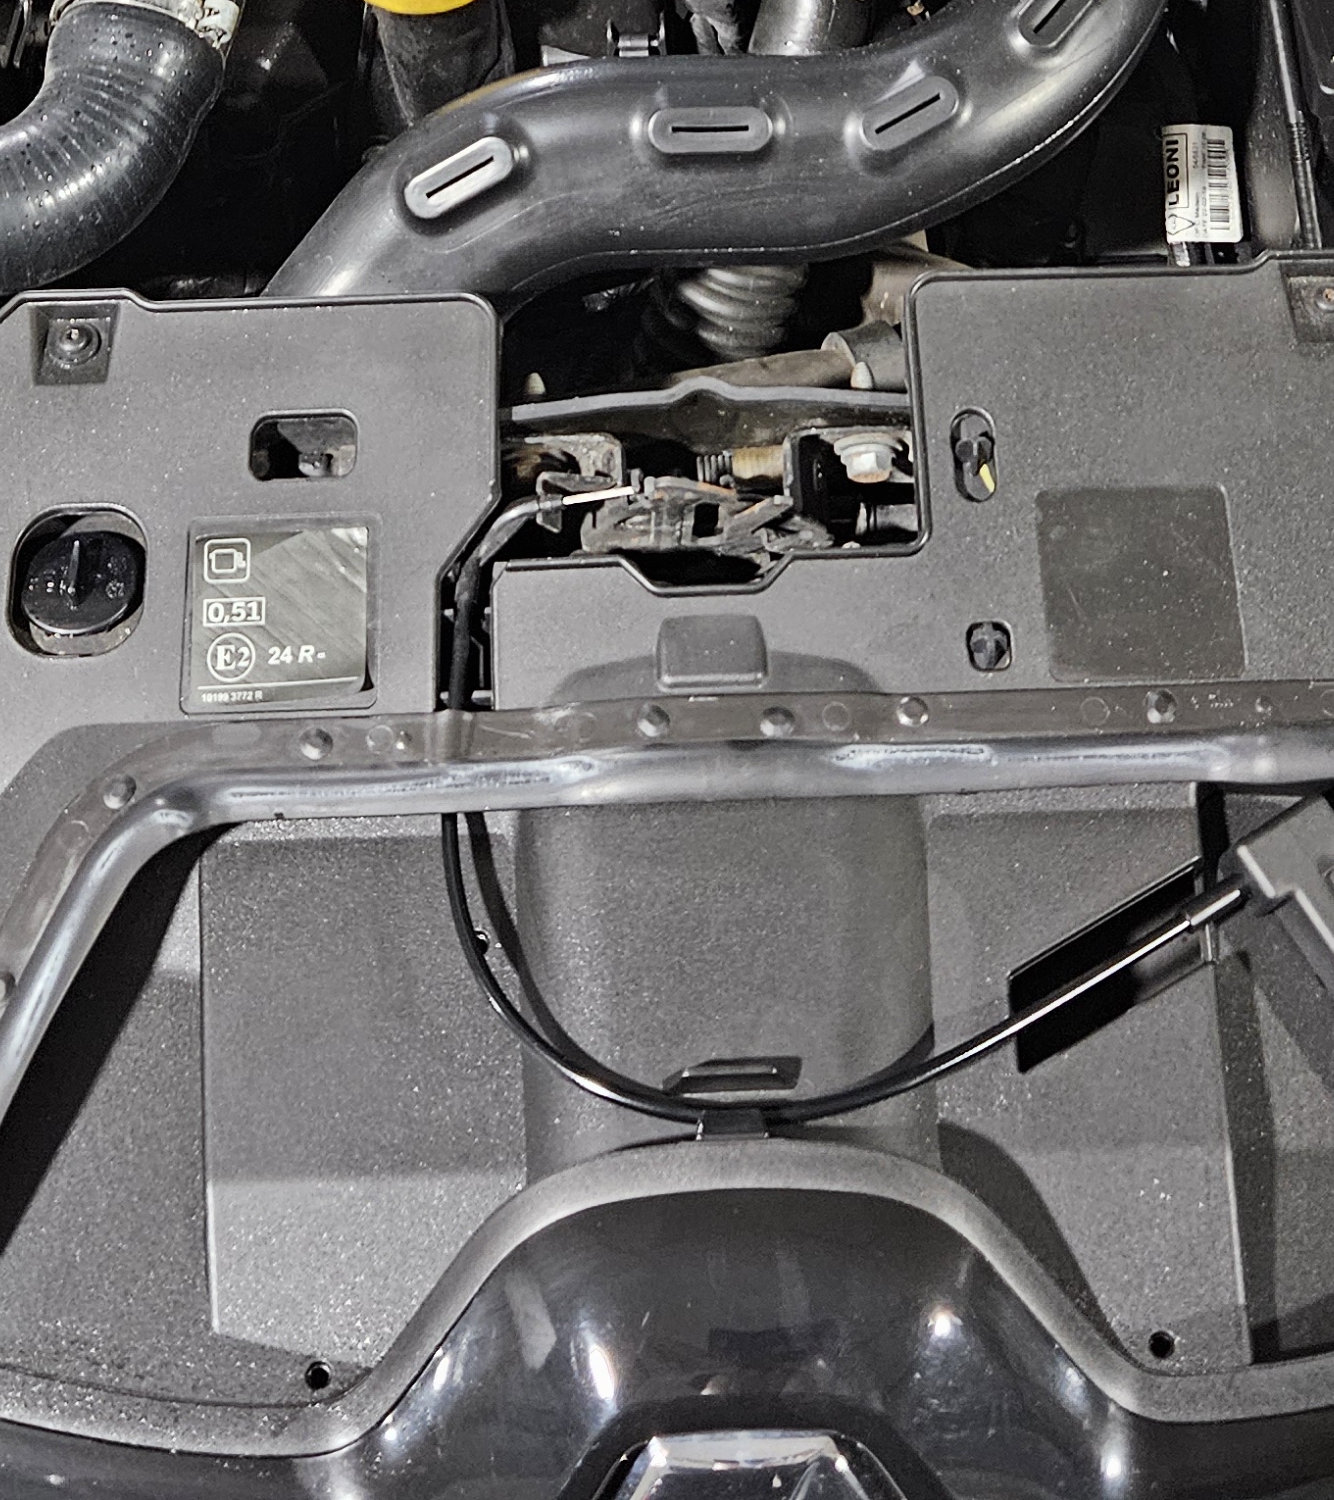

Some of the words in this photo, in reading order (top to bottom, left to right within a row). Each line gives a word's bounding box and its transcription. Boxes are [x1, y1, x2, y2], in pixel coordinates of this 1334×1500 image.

[1166, 139, 1180, 206] LEONI
[208, 601, 261, 624] 0,51
[268, 646, 293, 665] 24
